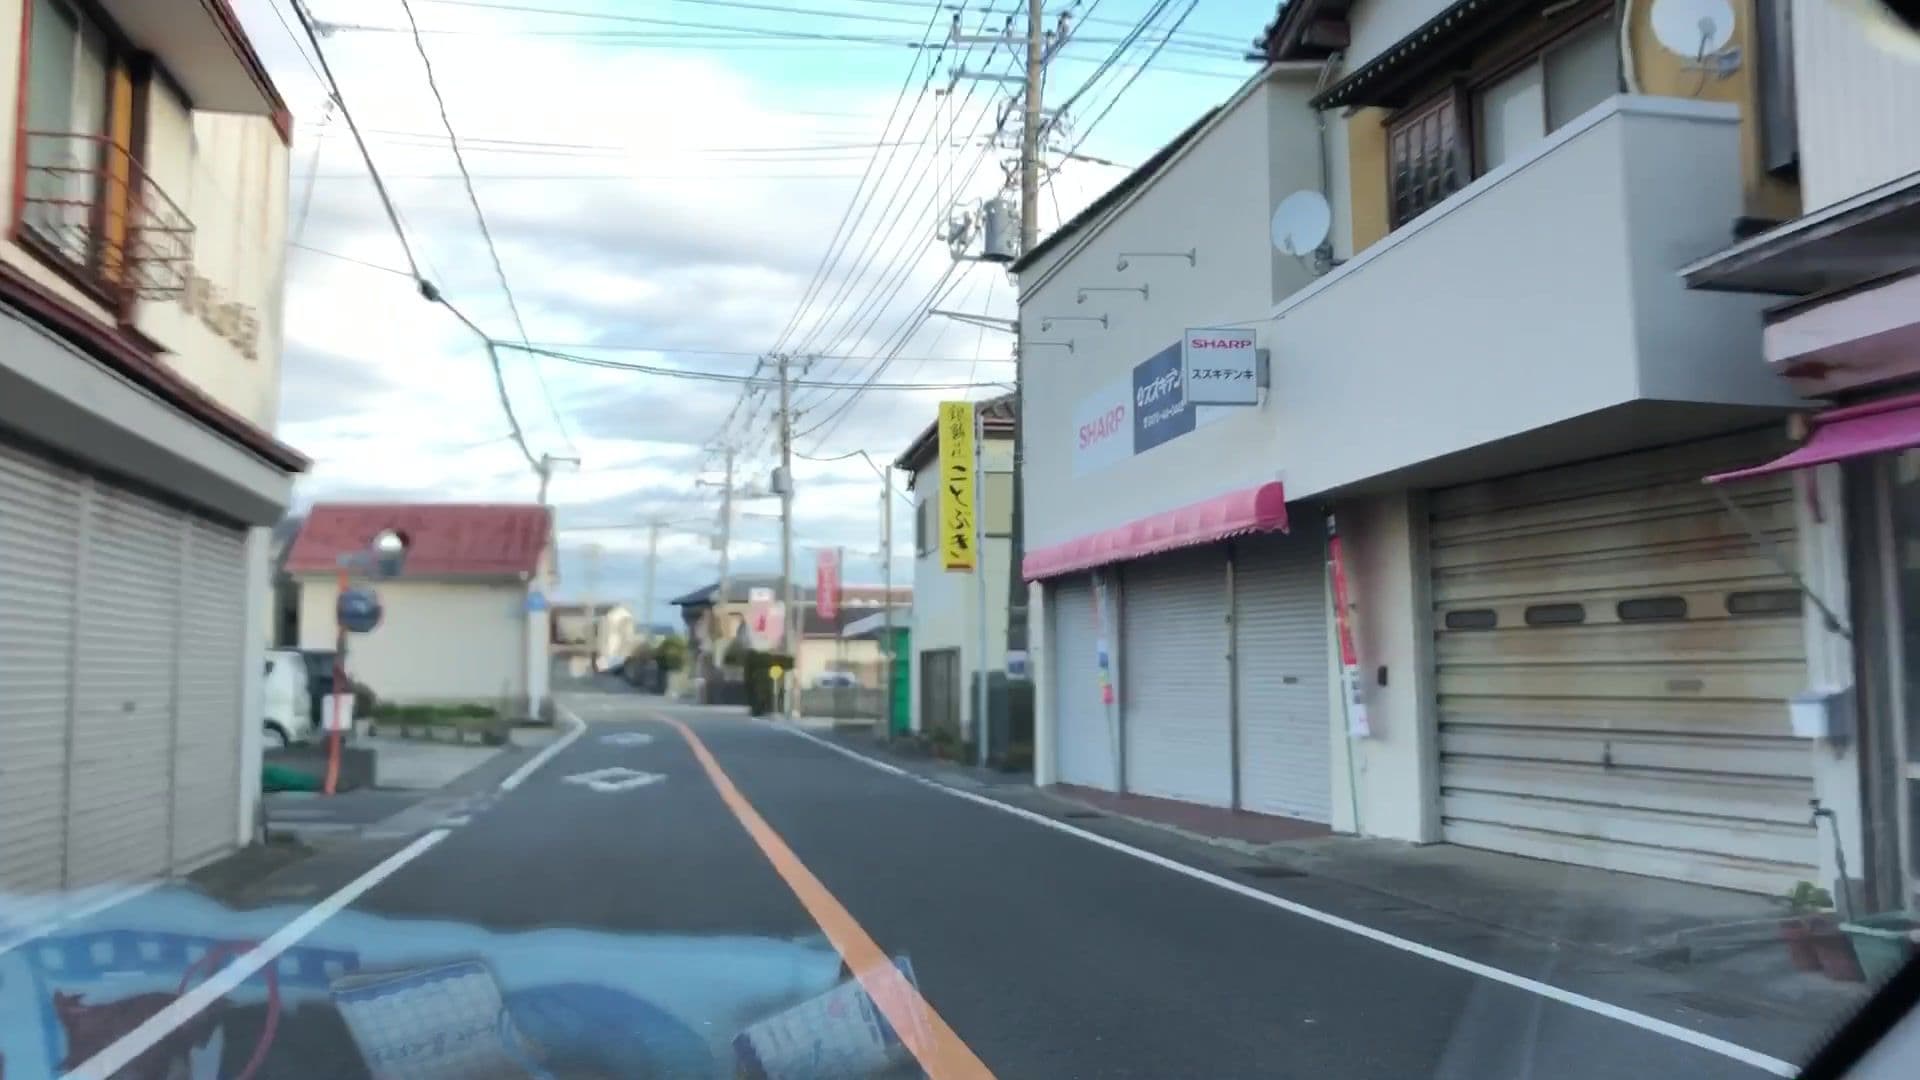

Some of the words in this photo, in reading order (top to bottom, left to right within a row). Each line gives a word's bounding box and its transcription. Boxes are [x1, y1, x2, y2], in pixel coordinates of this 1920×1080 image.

[1191, 339, 1253, 349] SHARP
[1191, 368, 1255, 380] スズキデンキ
[1079, 404, 1126, 450] SHARP
